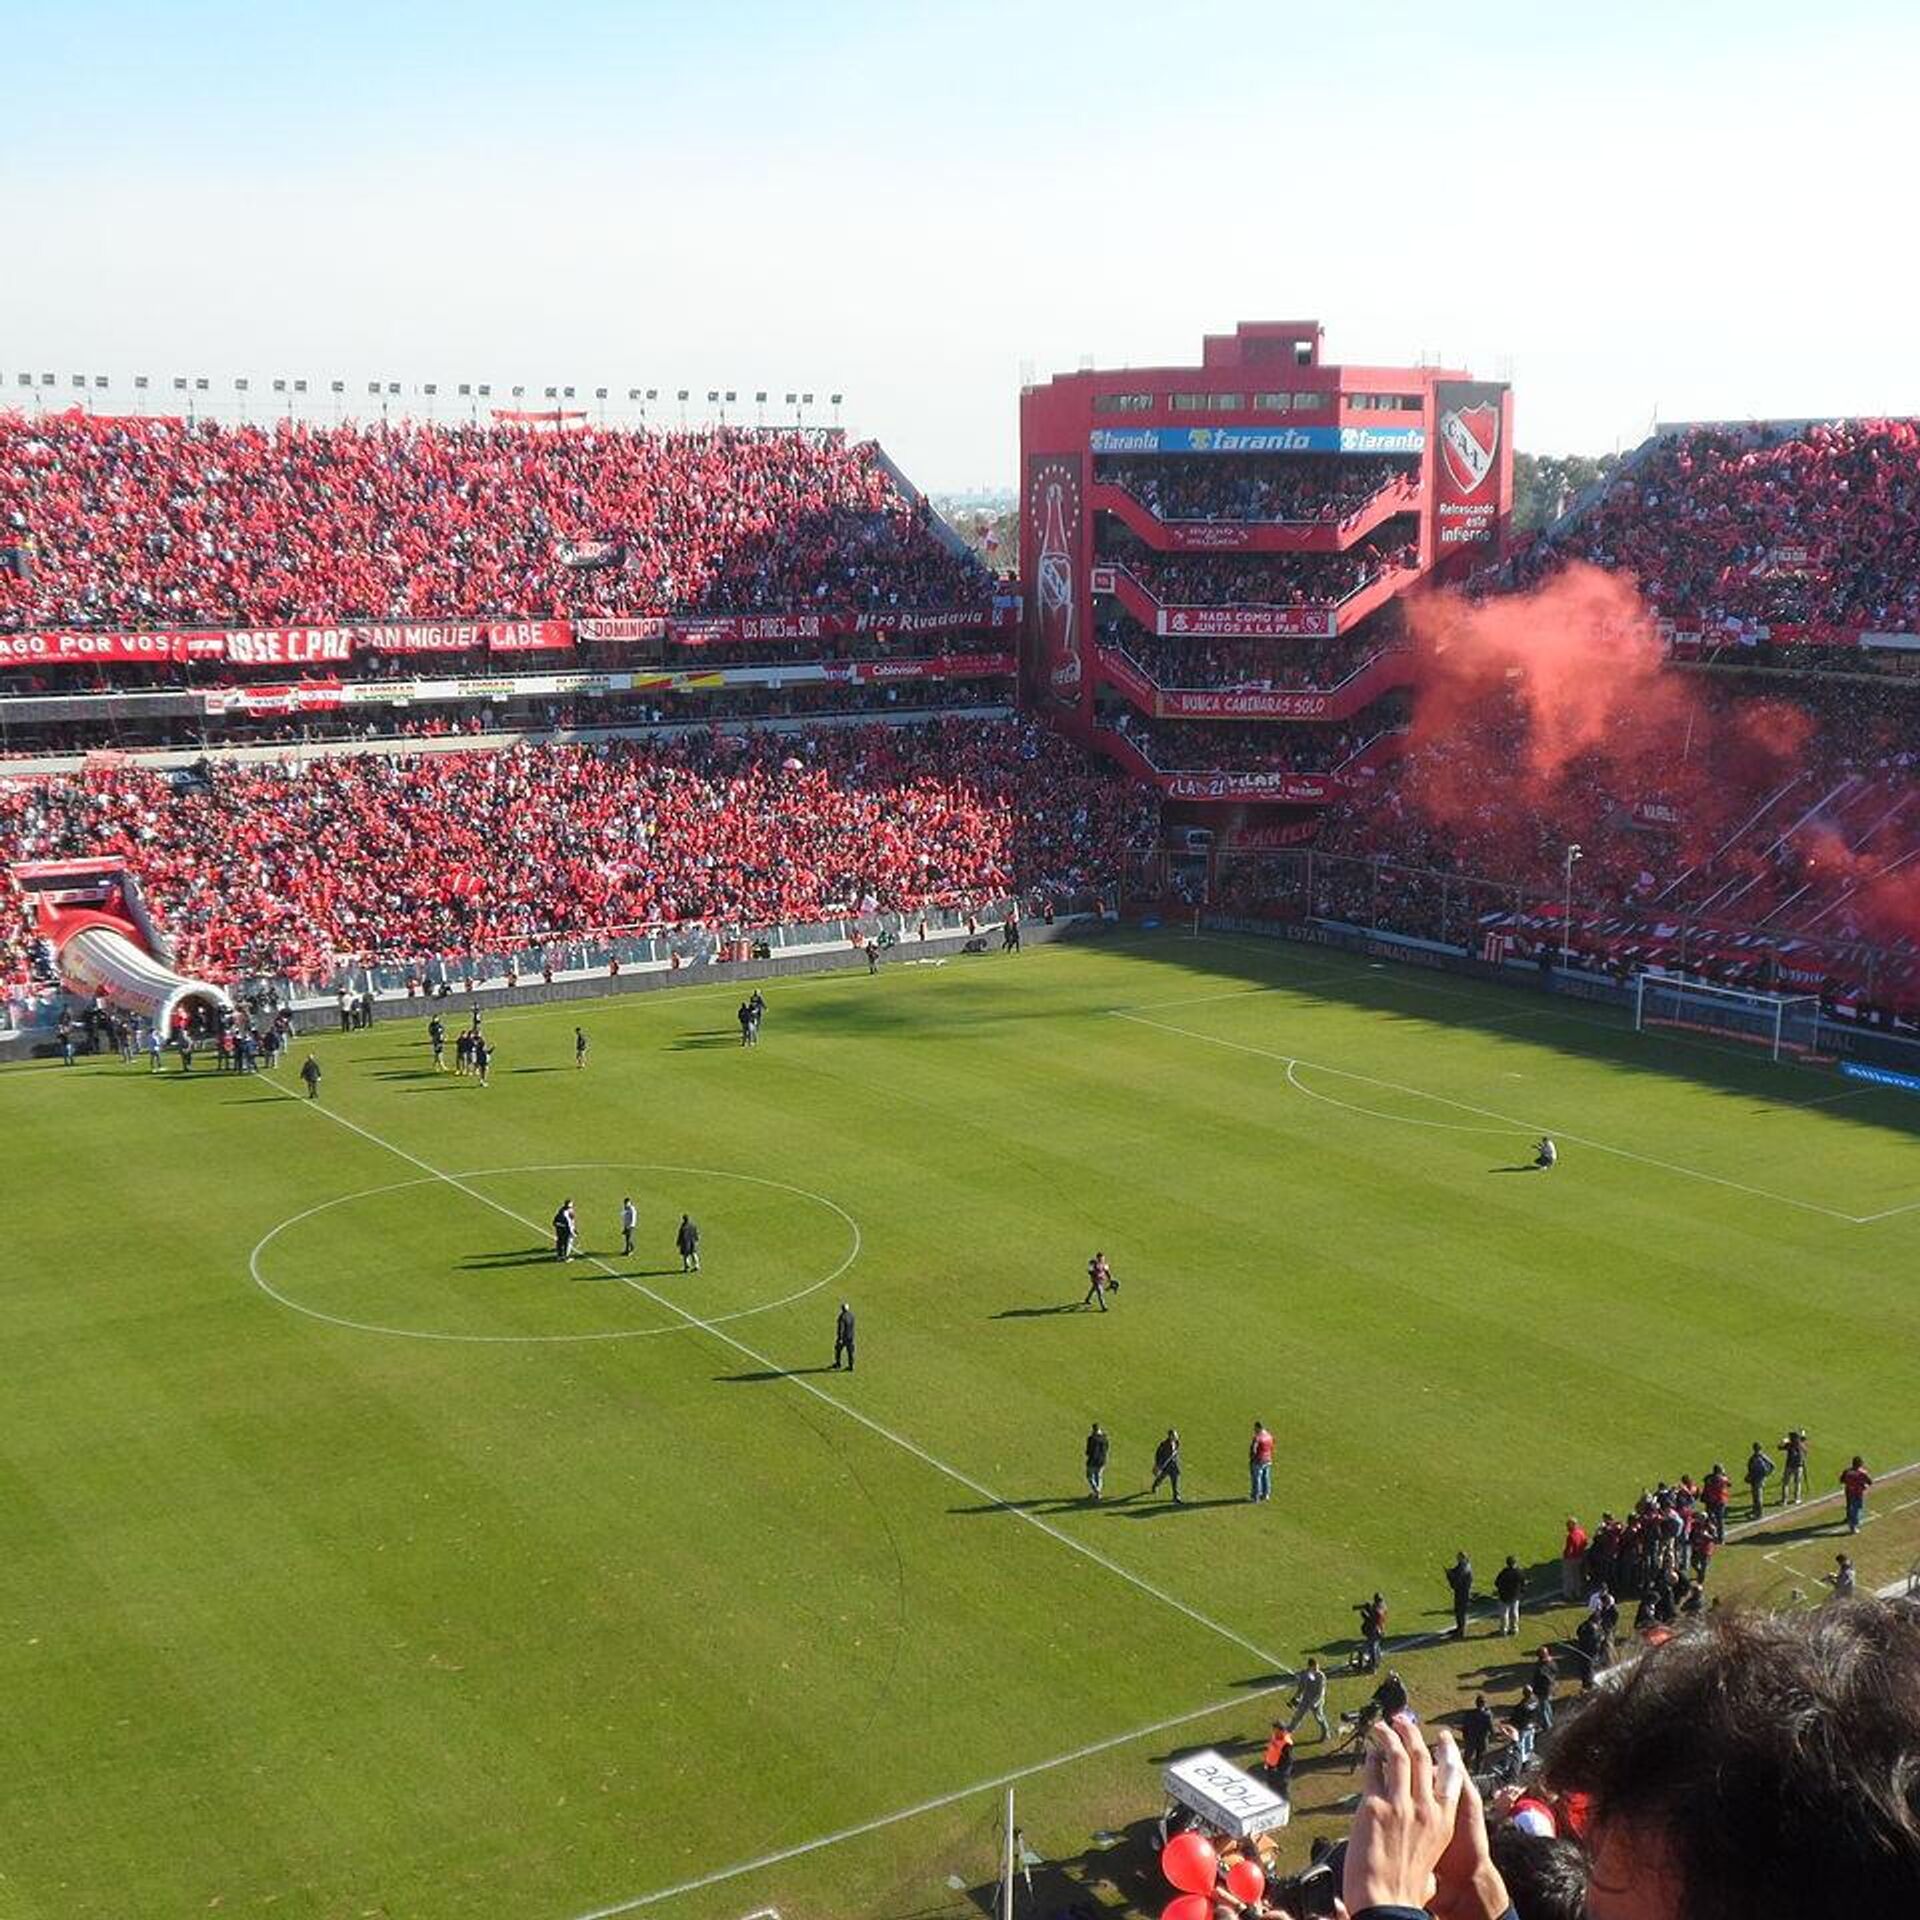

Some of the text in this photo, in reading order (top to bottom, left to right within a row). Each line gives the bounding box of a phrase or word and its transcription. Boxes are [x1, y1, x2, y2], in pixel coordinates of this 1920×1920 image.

[1104, 429, 1159, 448] taranto
[1213, 428, 1310, 449] taranto
[1357, 429, 1424, 449] taranto
[899, 610, 984, 632] Rivadavia
[1198, 611, 1232, 622] NADA
[1236, 612, 1272, 622] COMO
[355, 625, 482, 648] SAN MIGUEL
[491, 623, 545, 646] CABE
[1190, 622, 1240, 632] JUNTOS
[1243, 623, 1253, 632] A
[1256, 623, 1273, 633] LA
[59, 636, 111, 652] POR
[225, 631, 281, 661] JOSE
